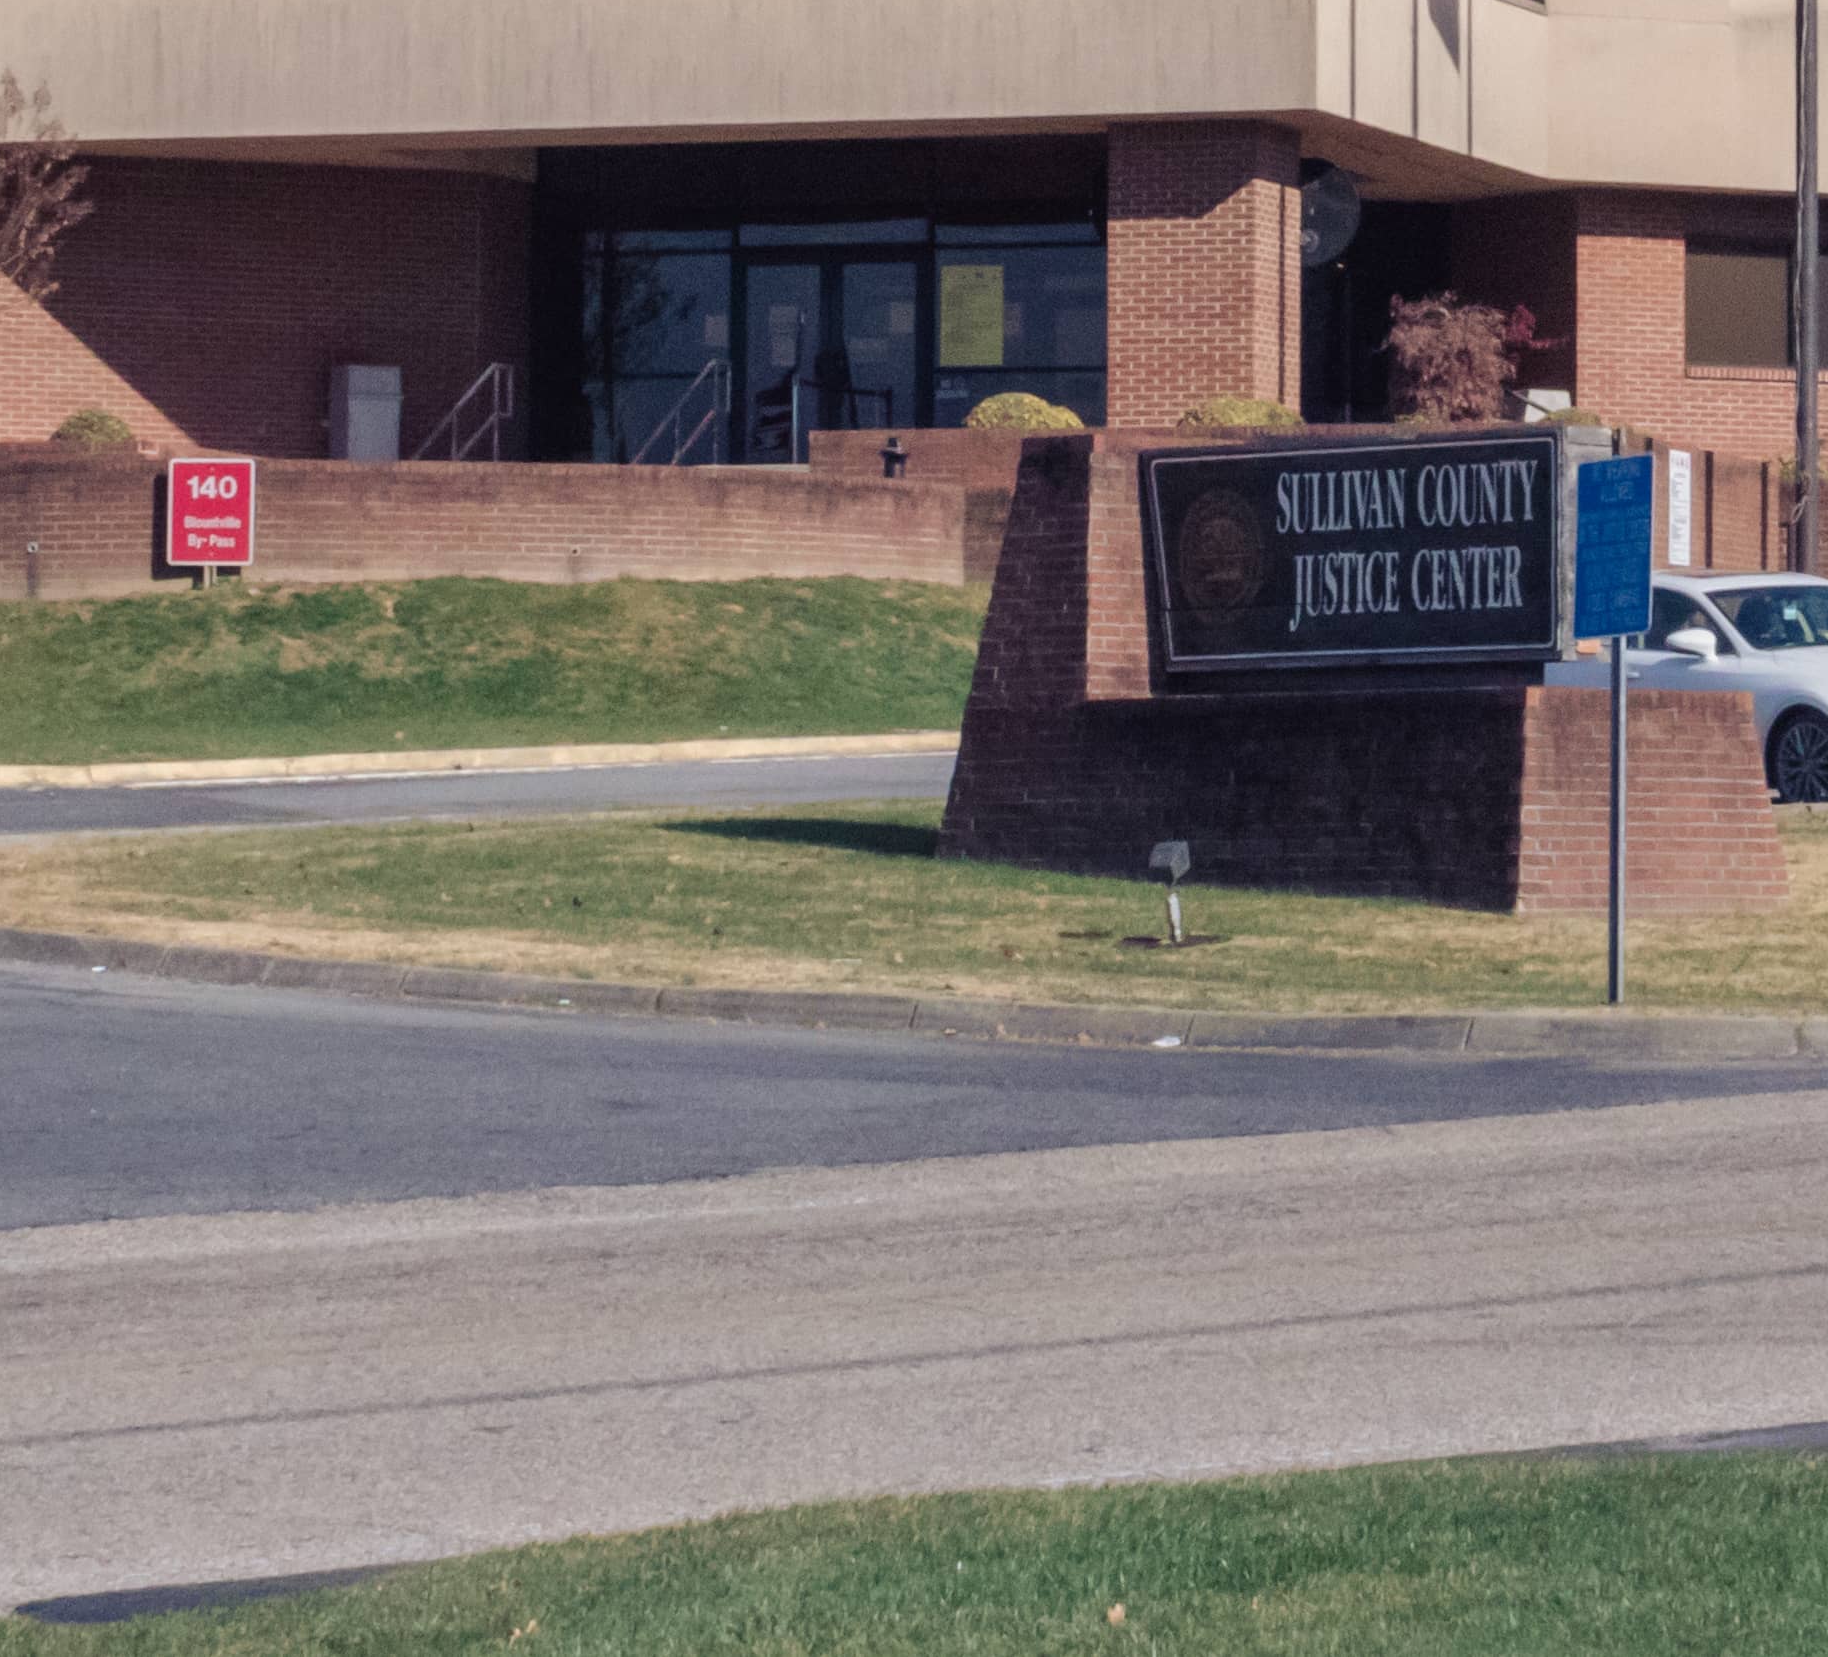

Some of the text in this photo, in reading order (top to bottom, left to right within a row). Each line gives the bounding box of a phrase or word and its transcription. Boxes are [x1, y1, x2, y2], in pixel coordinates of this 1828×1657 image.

[186, 475, 238, 499] 140
[1276, 459, 1538, 534] SULLIVAN COUNTY
[183, 515, 241, 529] Blountville
[209, 533, 236, 548] Pass
[1289, 551, 1400, 632] JUSTICE
[1411, 545, 1523, 611] CENTER
